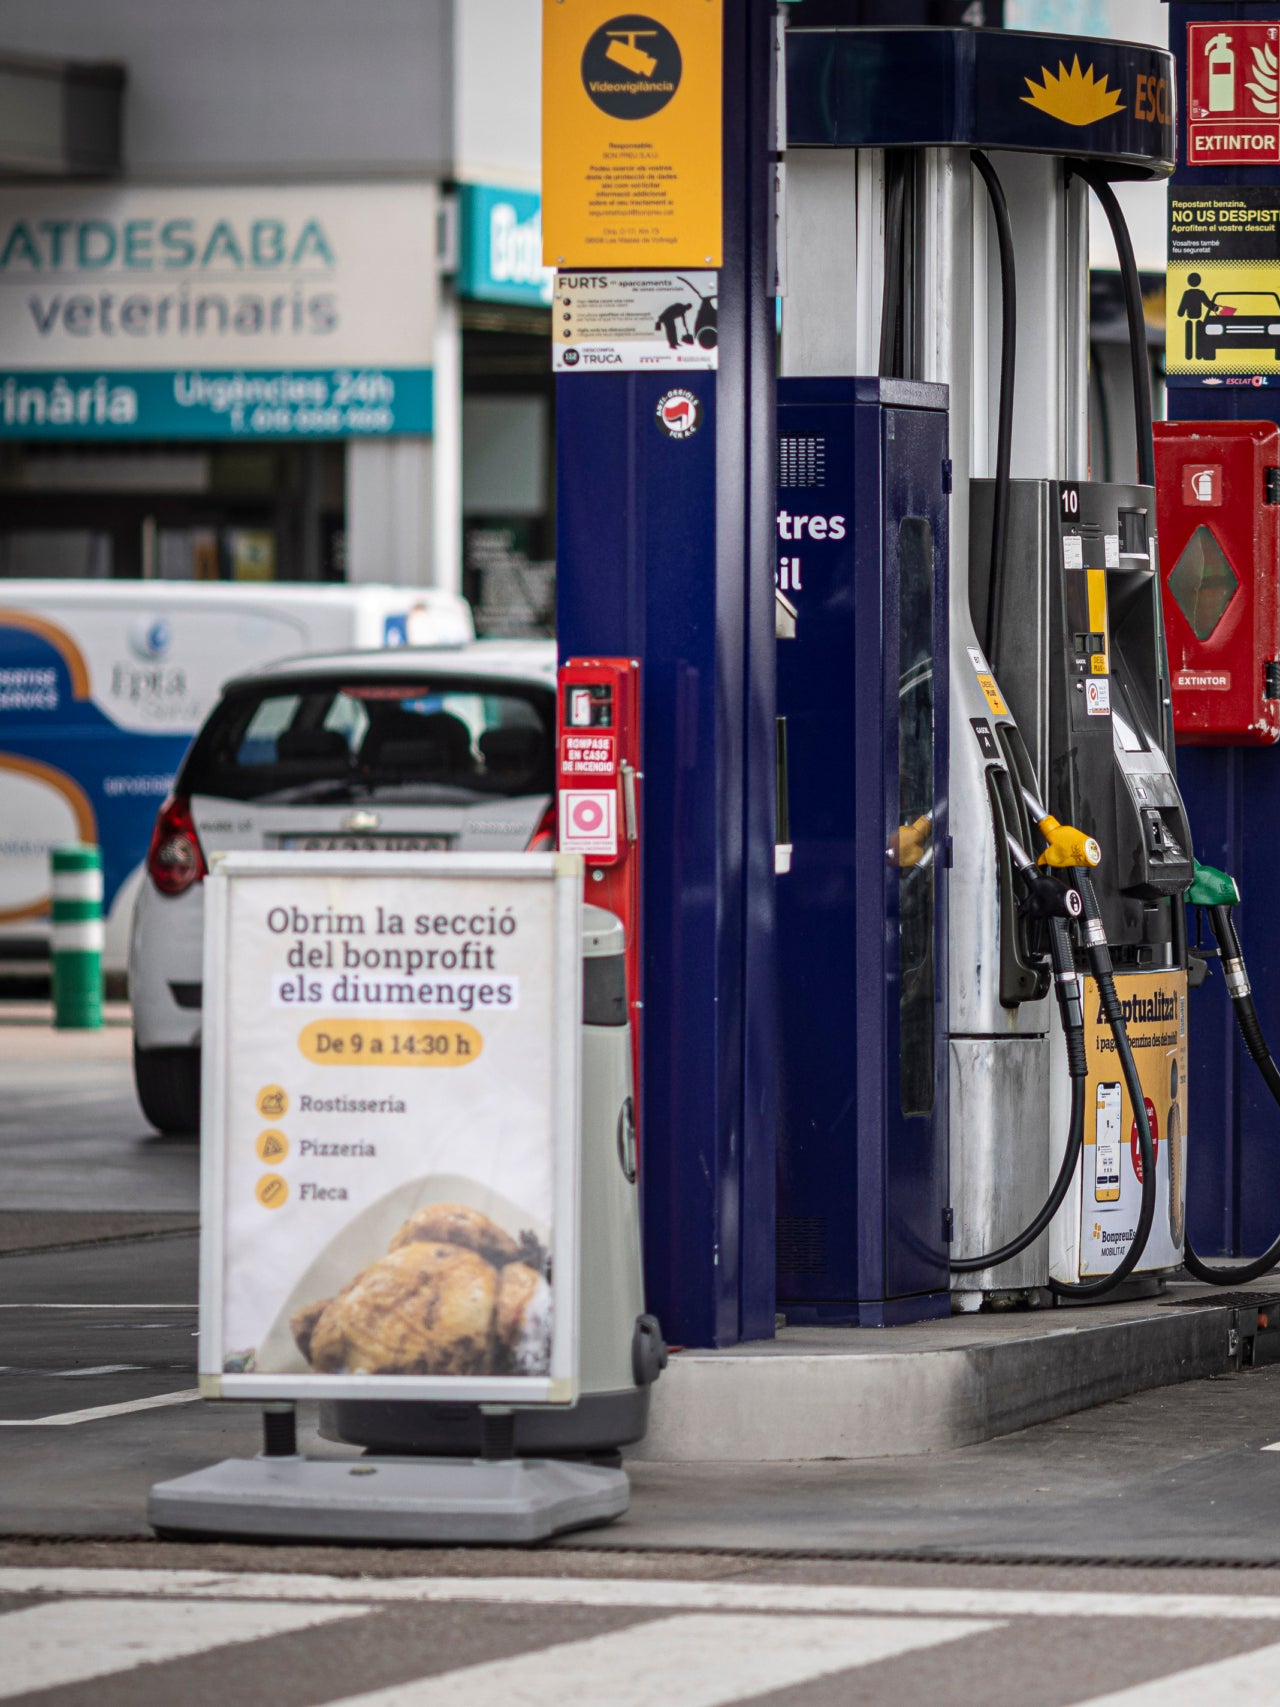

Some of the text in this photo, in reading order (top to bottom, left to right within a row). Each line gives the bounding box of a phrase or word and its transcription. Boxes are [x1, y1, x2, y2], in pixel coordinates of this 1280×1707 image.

[588, 80, 675, 95] Videovigilància
[1195, 134, 1276, 151] EXTINTOR
[1171, 200, 1247, 209] Repostant benzina,
[1172, 210, 1193, 222] NO
[1196, 210, 1216, 222] US
[1171, 224, 1275, 233] Aprofiten el vostre descuit
[1183, 247, 1211, 255] seguretat
[1200, 239, 1220, 247] també
[558, 276, 608, 289] FURTS
[617, 279, 673, 288] aparcaments
[28, 278, 339, 338] veterinaris
[582, 354, 623, 364] TRUCA
[0, 376, 138, 426] inària
[1062, 489, 1078, 513] 10
[776, 510, 847, 540] tres
[775, 556, 803, 591] il
[1178, 676, 1227, 686] EXTINTOR
[568, 749, 609, 761] EN CASO
[562, 761, 614, 773] DE INCENDIO
[266, 905, 516, 936] Obrim la secció
[287, 940, 496, 977] del bonprofit
[279, 974, 512, 1012] els diumenges
[315, 1033, 471, 1056] De 9 a 14:30 h
[1096, 1035, 1100, 1050] i
[299, 1095, 407, 1113] Rostisseria
[299, 1139, 377, 1158] Pizzeria
[299, 1182, 349, 1201] Fleca
[1101, 1246, 1126, 1257] MOBILITAT
